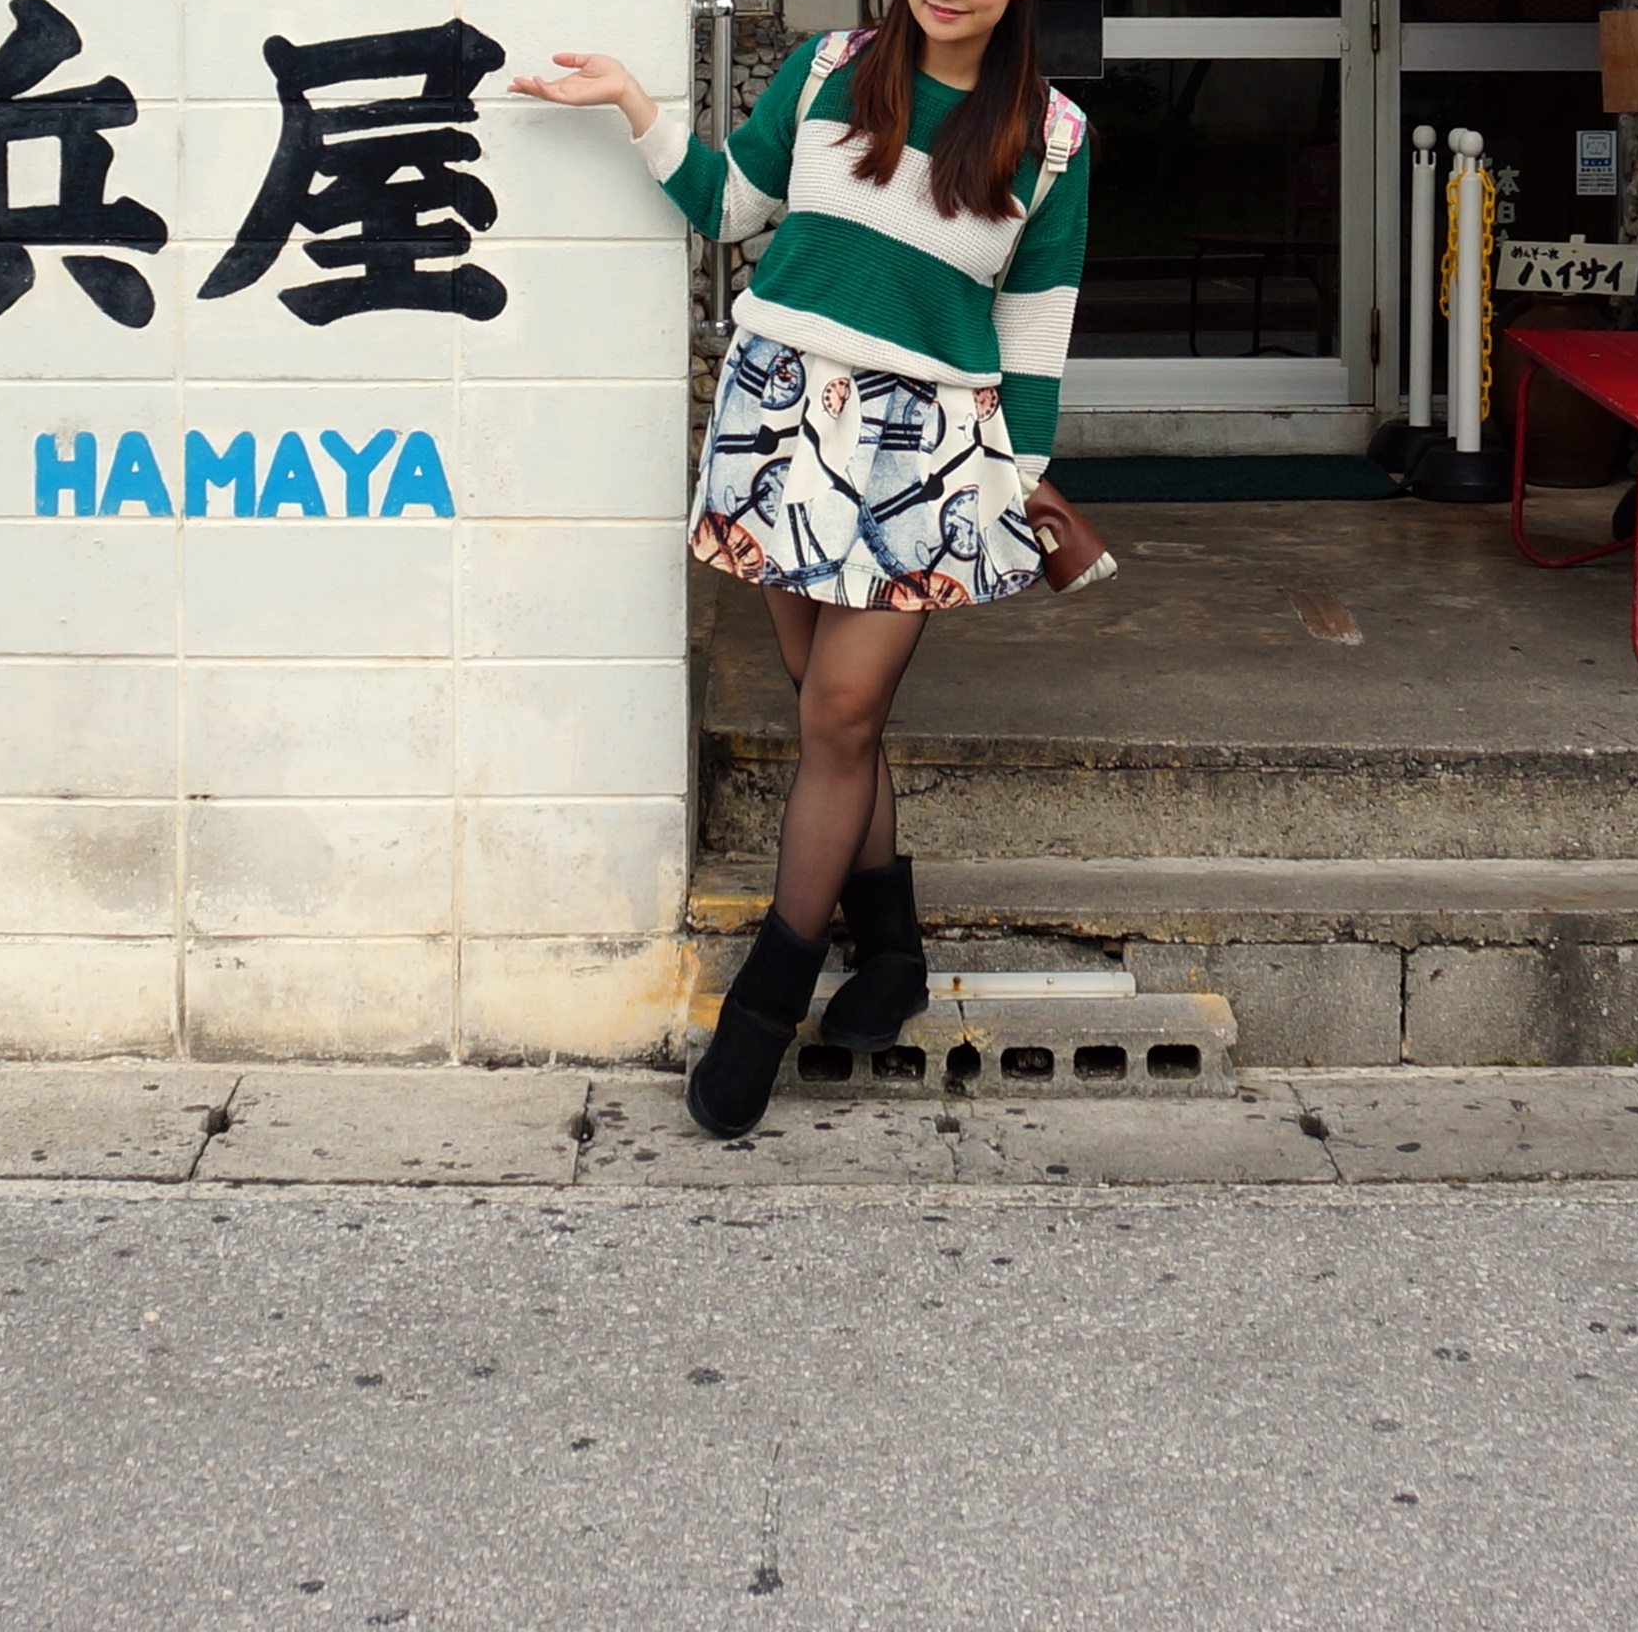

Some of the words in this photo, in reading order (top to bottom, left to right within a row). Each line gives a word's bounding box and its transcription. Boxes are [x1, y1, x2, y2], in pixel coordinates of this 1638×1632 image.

[1518, 257, 1623, 291] ハイサイ
[34, 429, 455, 518] HAMAYA
